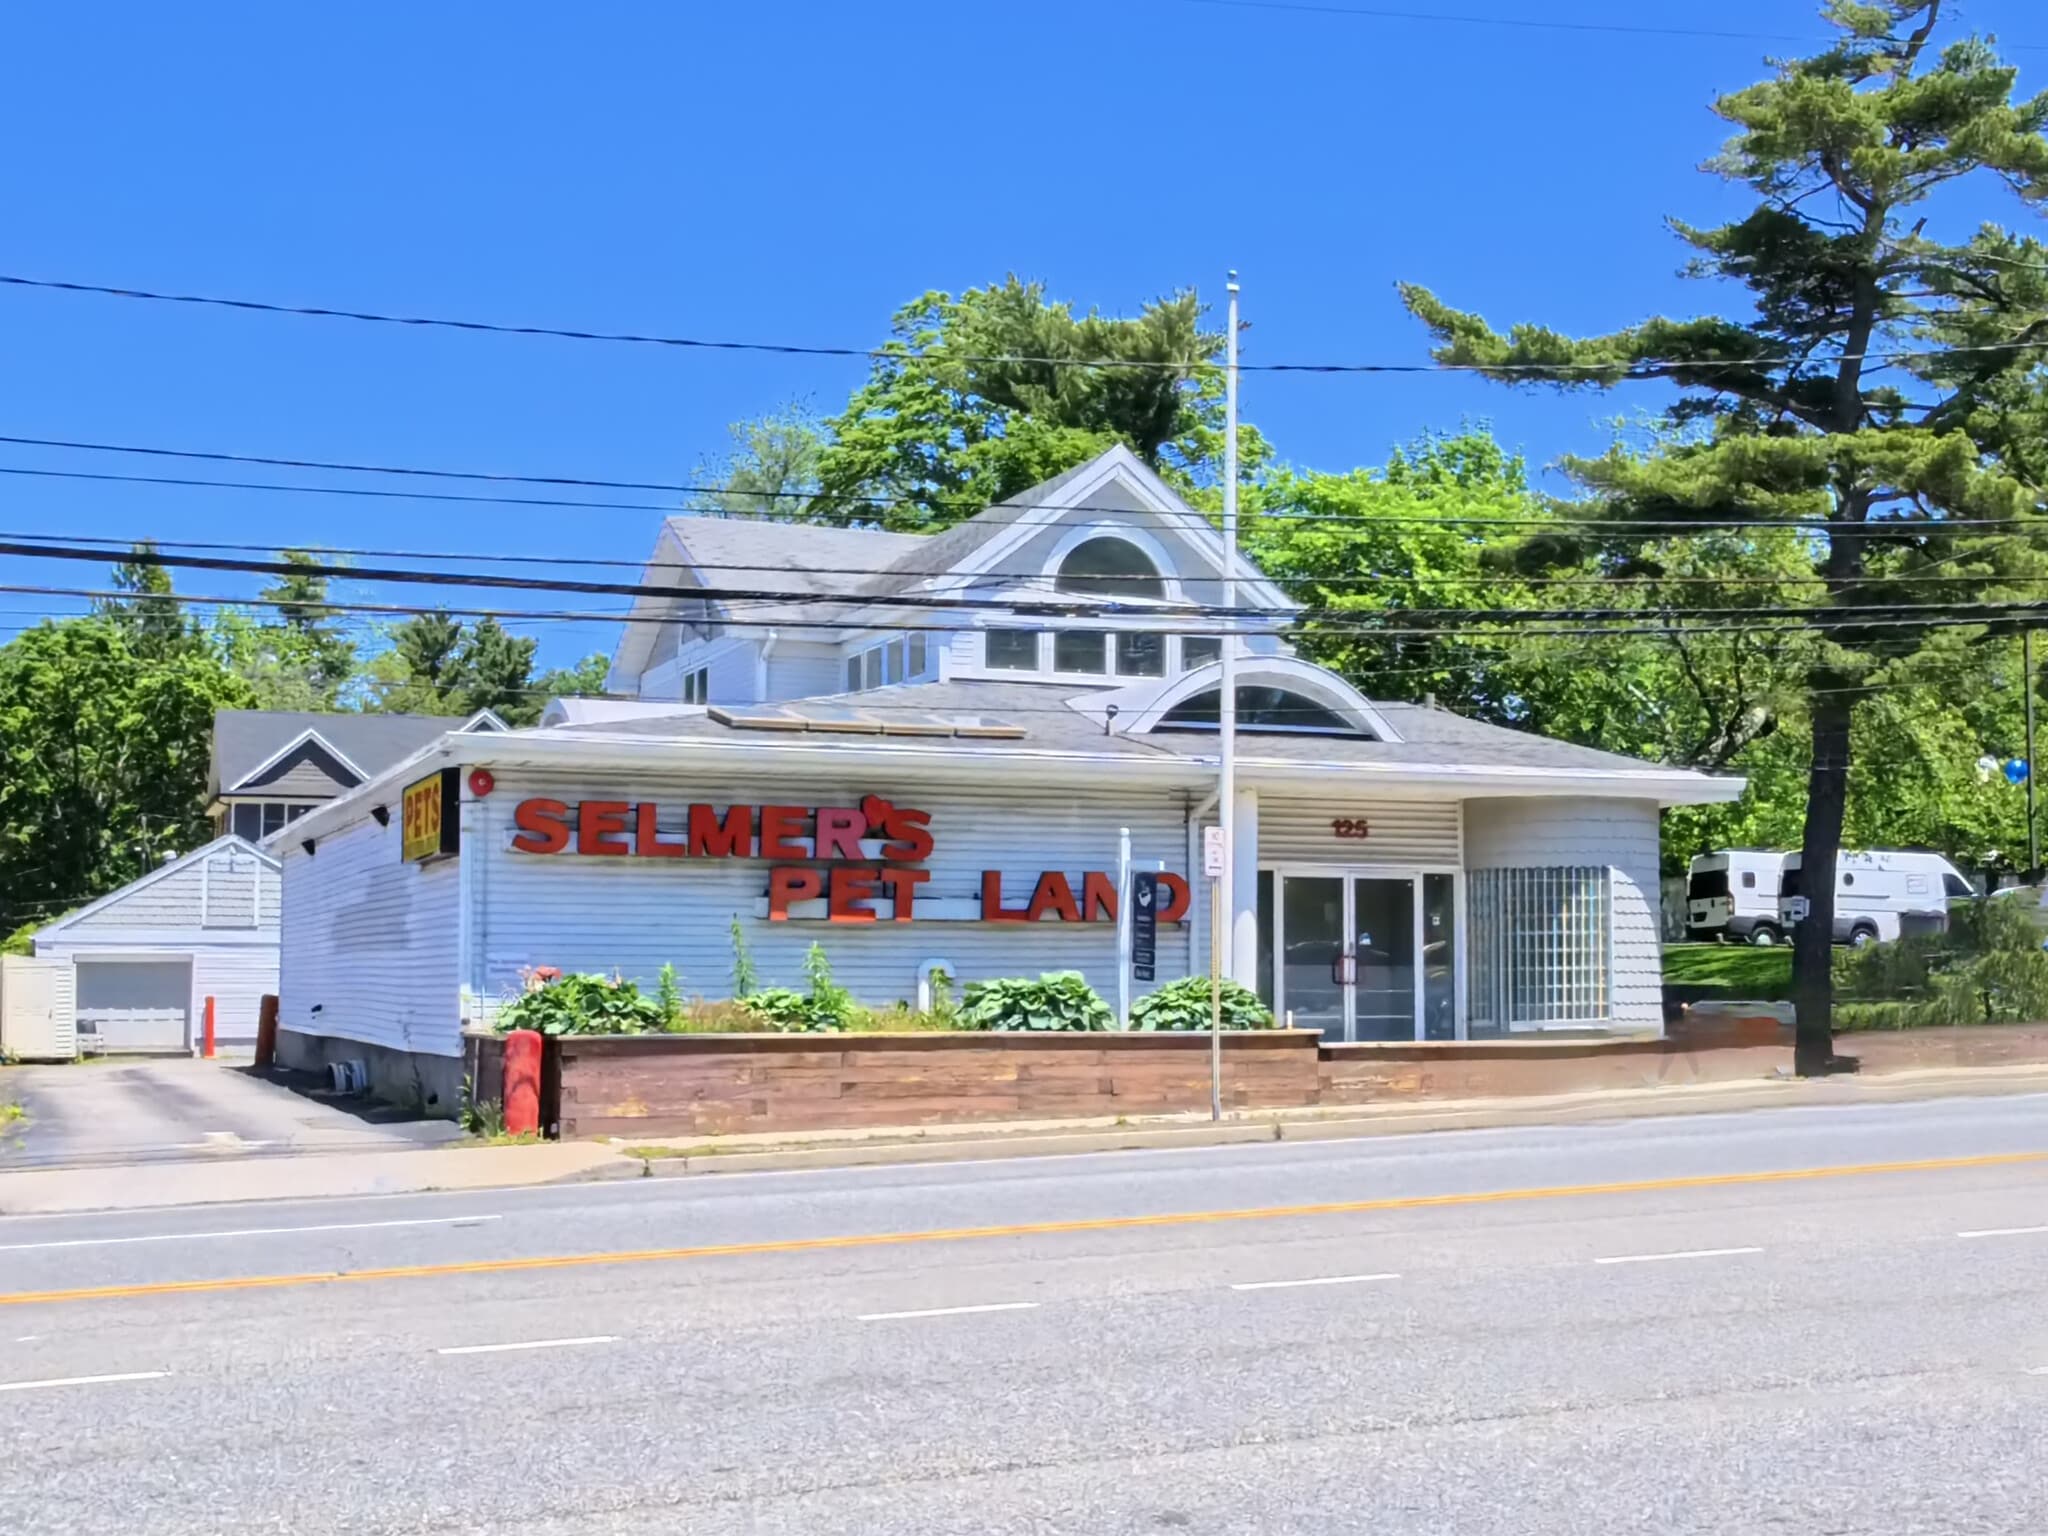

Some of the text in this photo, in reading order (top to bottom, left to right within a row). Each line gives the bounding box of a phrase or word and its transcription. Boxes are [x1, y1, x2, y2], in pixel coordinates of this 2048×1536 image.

[405, 781, 440, 842] PETS
[1331, 818, 1368, 839] 125
[769, 865, 1191, 922] PET LAND
